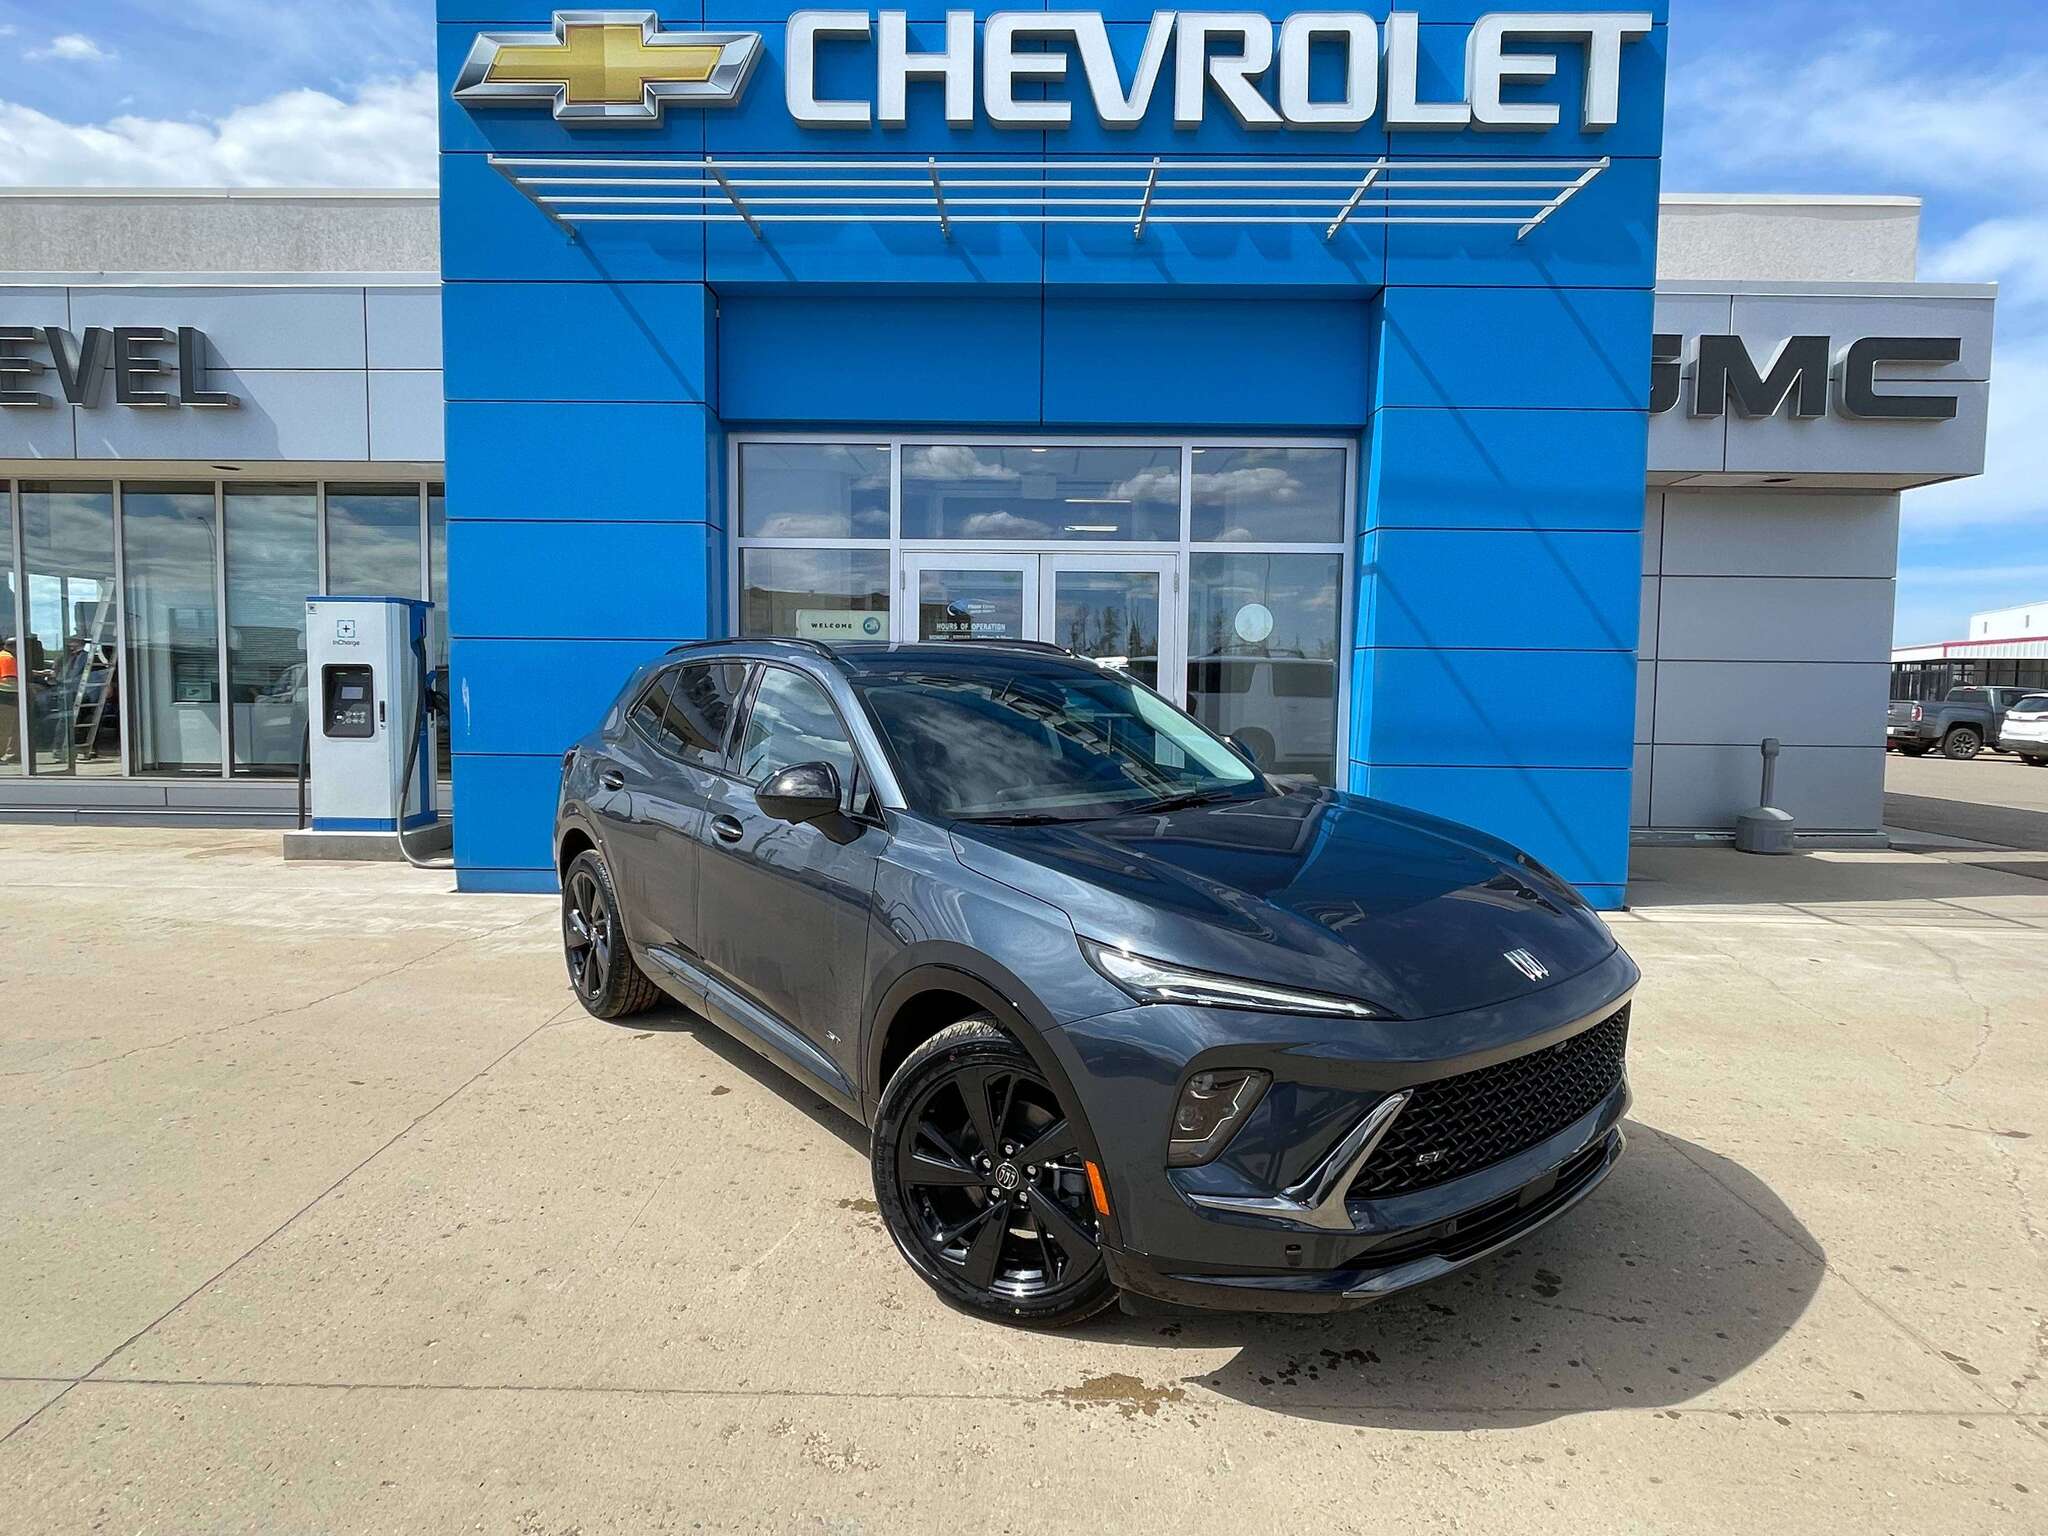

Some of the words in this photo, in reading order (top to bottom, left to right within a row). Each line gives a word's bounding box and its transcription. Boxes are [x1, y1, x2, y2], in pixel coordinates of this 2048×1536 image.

[785, 10, 1654, 131] CHEVROLET
[936, 622, 958, 630] HOURS
[960, 622, 969, 630] OF
[971, 623, 1006, 631] OPERATION
